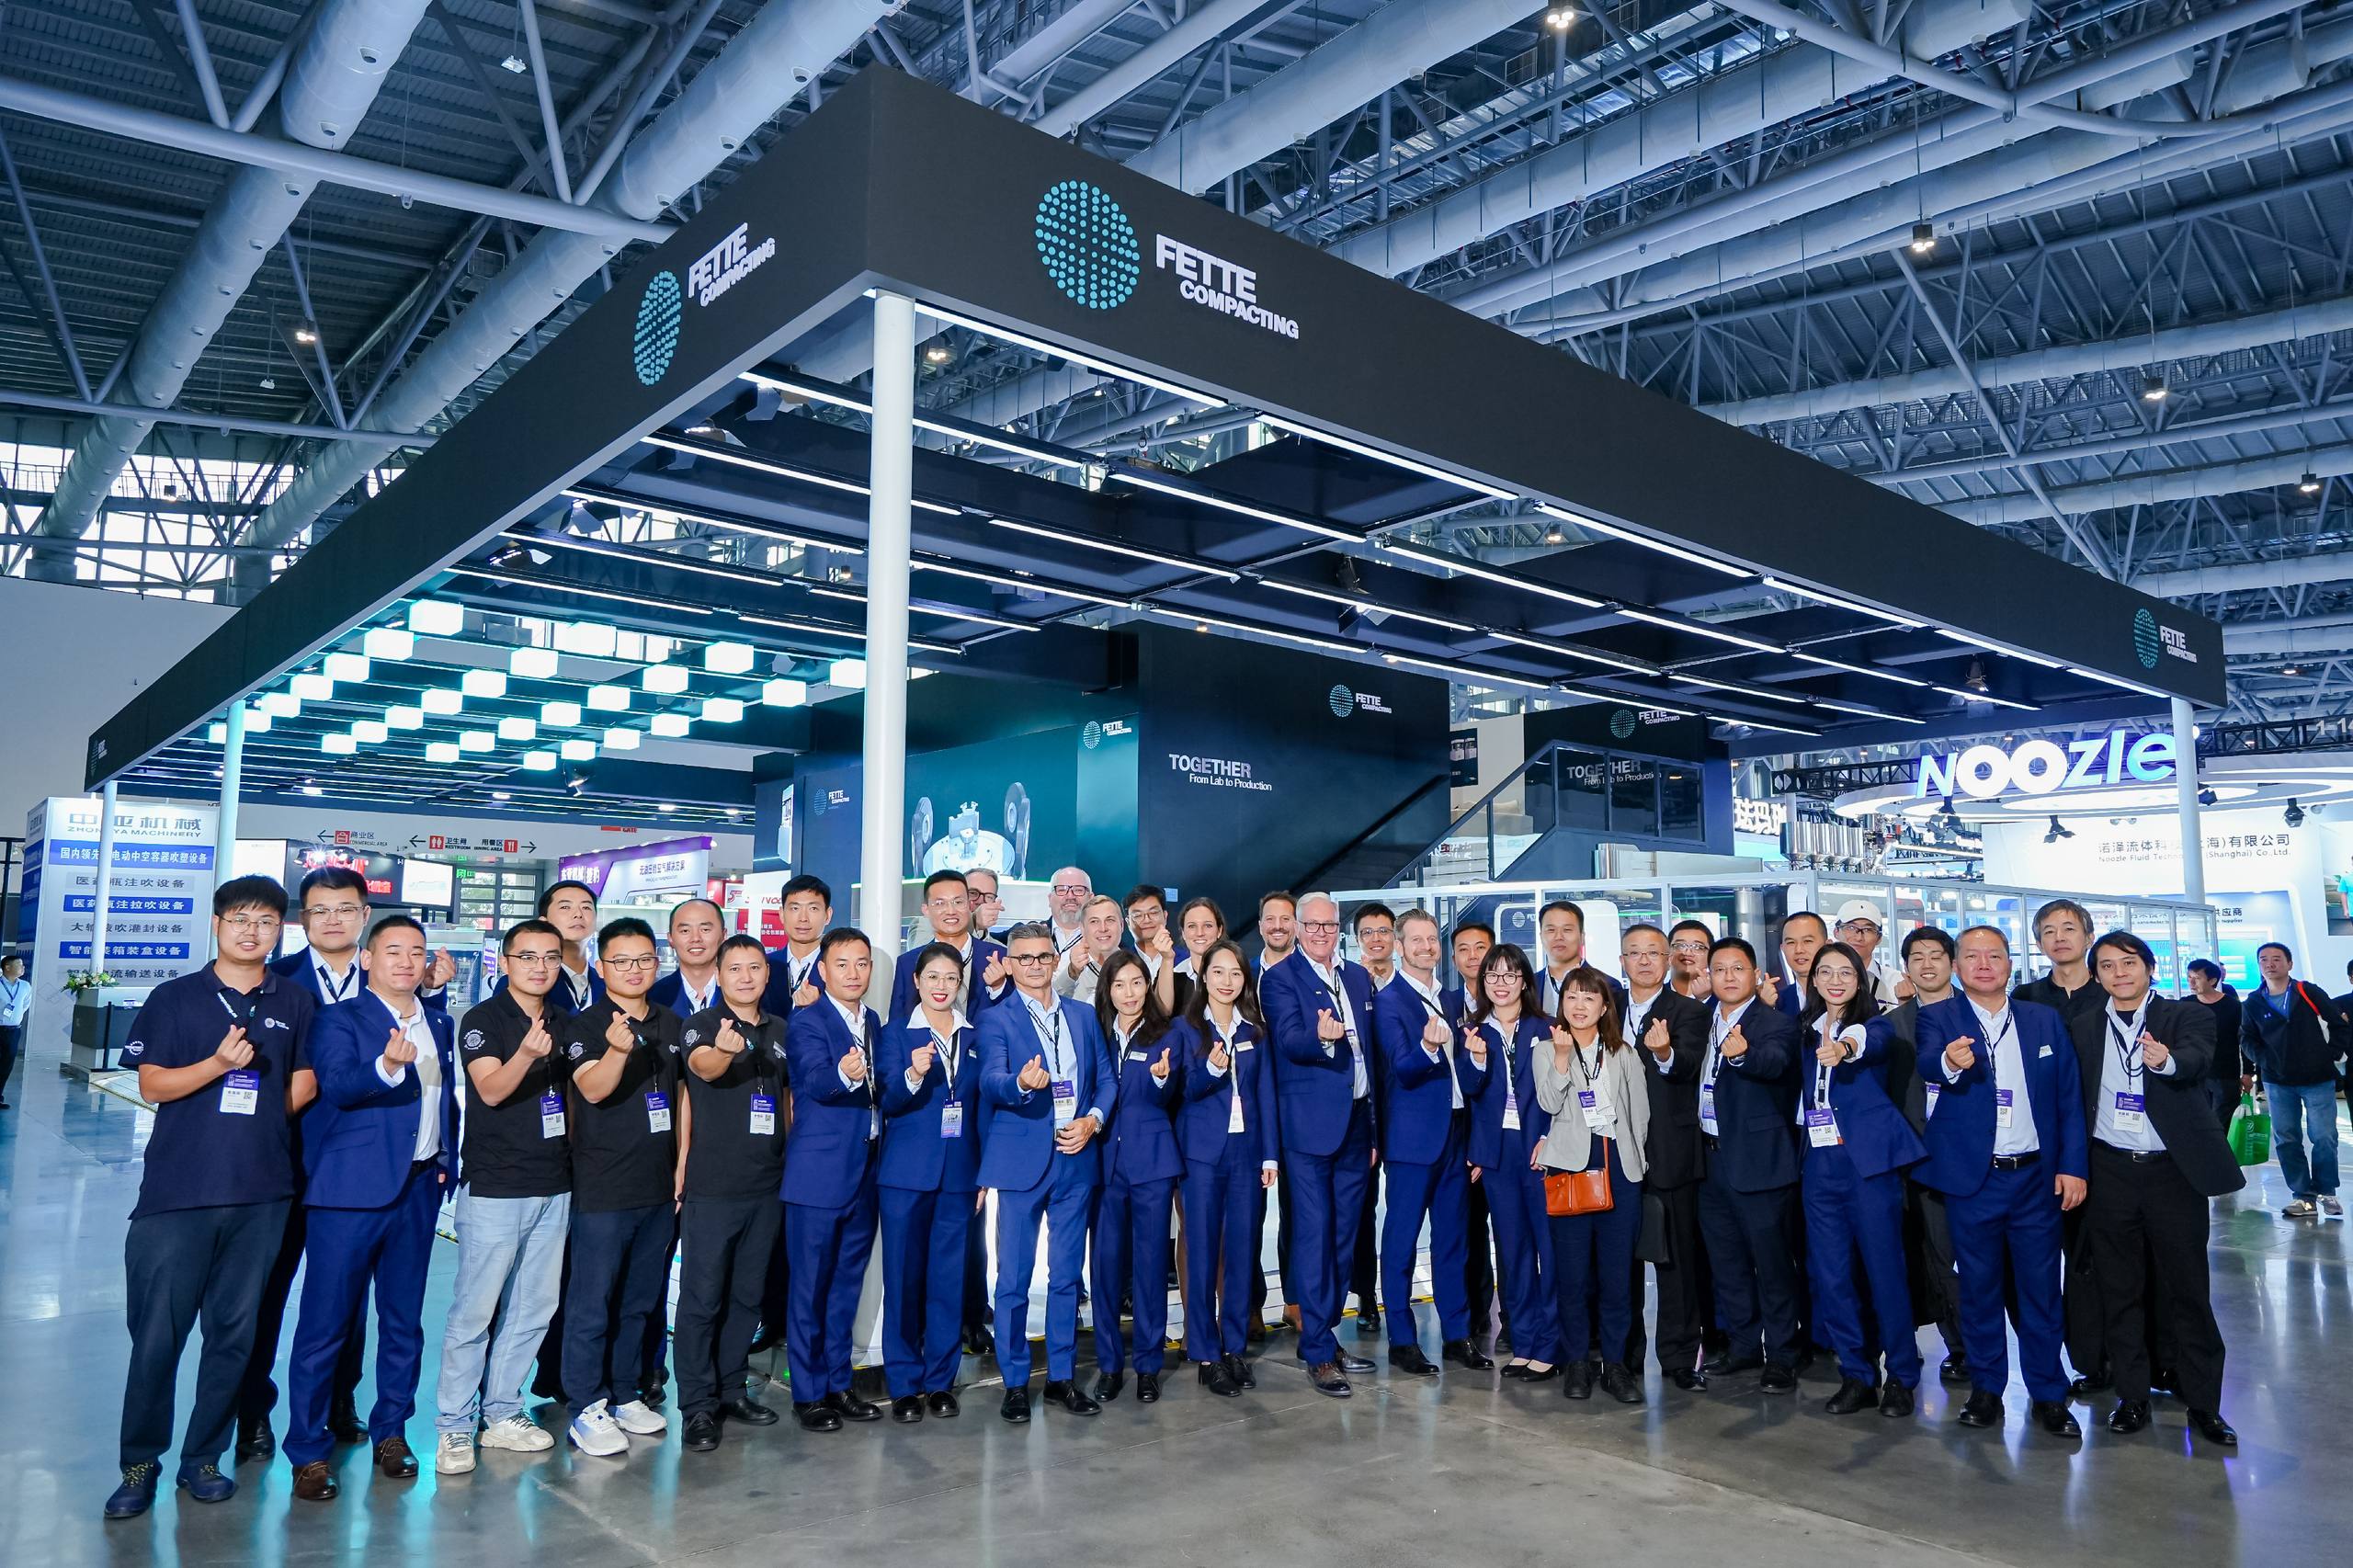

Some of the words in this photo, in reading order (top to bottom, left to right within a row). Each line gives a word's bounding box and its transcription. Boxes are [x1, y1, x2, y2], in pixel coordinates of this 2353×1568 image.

[688, 222, 748, 298] FETTE
[1155, 233, 1256, 303] FETTE
[699, 237, 776, 307] COMPACTING
[1179, 279, 1299, 339] COMPACTING
[2159, 625, 2187, 650] FETTE
[1355, 692, 1381, 706] FETTE
[1638, 710, 1666, 721] FETTE
[1102, 721, 1123, 733] FETTE
[1169, 753, 1252, 778] TOGETHER
[1566, 760, 1640, 778] TOGEHER
[1189, 774, 1209, 785] From
[1211, 776, 1224, 786] Lab
[1225, 778, 1233, 787] to
[1234, 778, 1272, 791] Production
[1602, 776, 1615, 784] Lb
[1625, 772, 1662, 782] Productin
[828, 790, 844, 800] FETTE
[67, 825, 129, 835] ZHONYA
[131, 830, 201, 838] MACHINERY
[350, 831, 374, 839] 商业区
[482, 838, 503, 846] 用餐区
[60, 846, 208, 865] 国内领先电动中空容器吹塑设备
